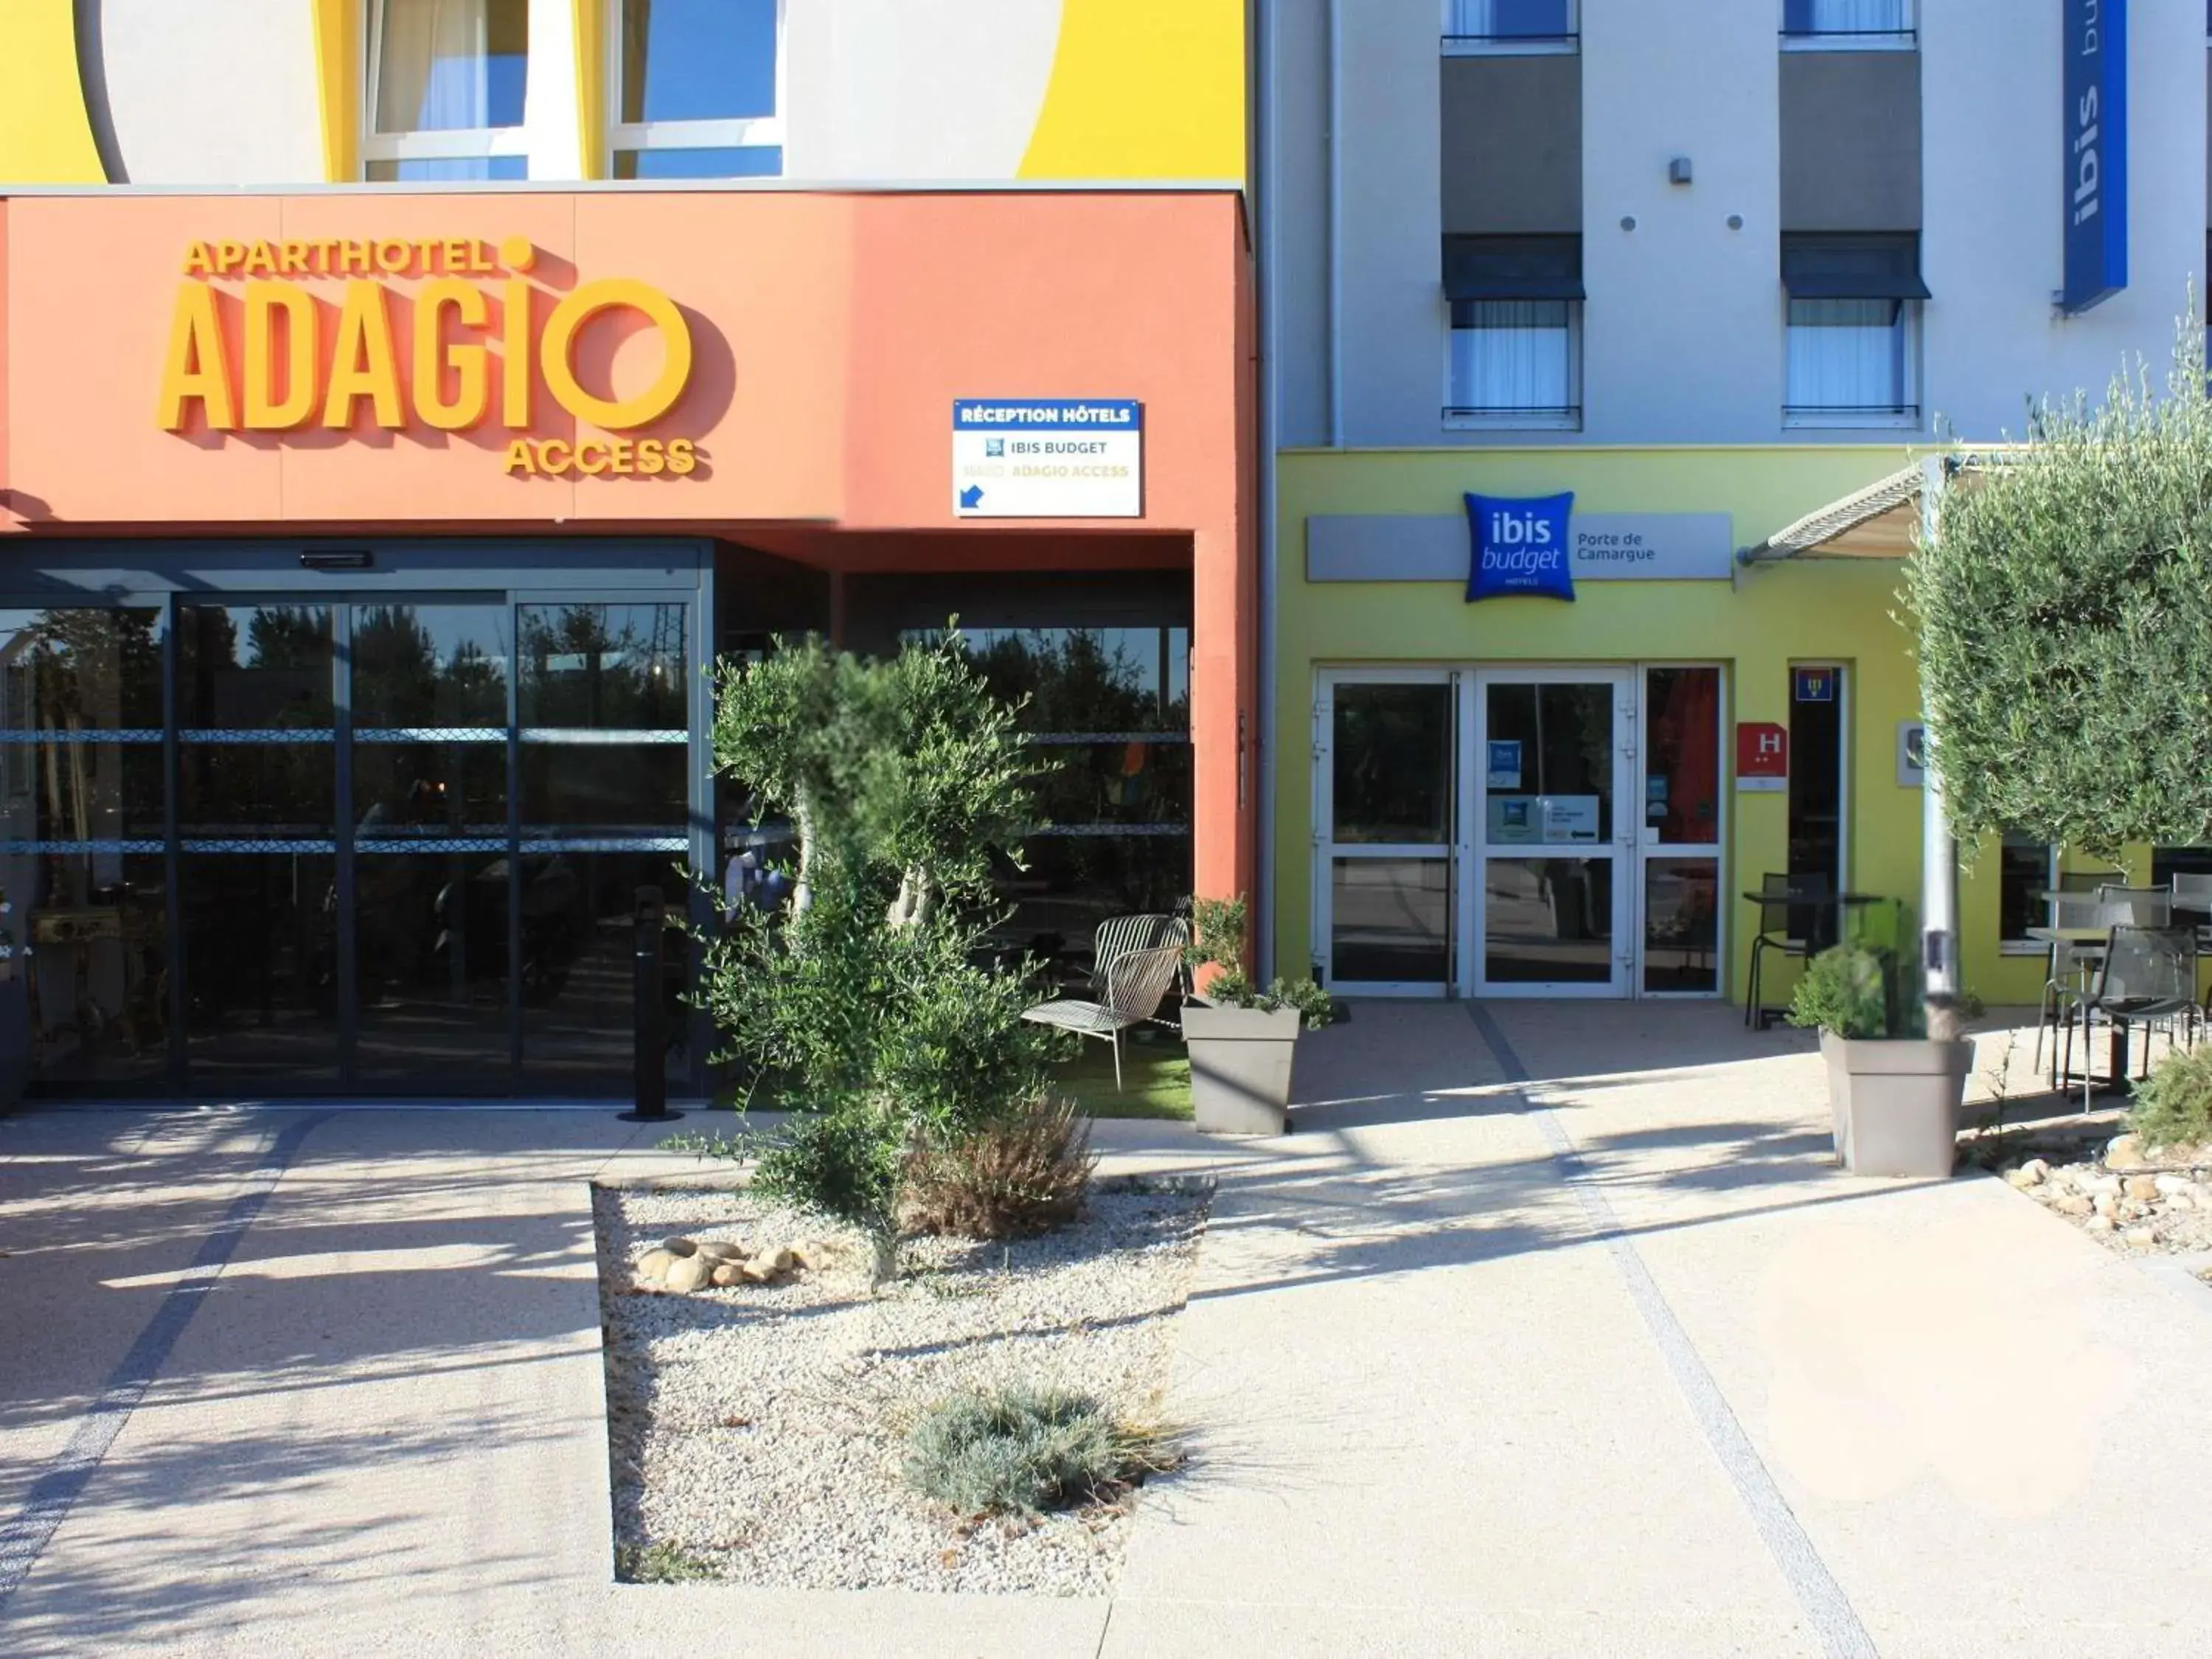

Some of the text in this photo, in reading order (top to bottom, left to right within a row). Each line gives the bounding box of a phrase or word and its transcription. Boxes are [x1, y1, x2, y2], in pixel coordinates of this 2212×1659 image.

[2074, 85, 2098, 226] ibis
[184, 237, 494, 275] APARTHOTEL
[961, 405, 1130, 423] RÉCEPTION HÔTELS
[504, 438, 696, 476] ACCESS
[1011, 442, 1108, 454] IBIS BUDGET
[1012, 465, 1069, 478] ADAGIO
[1071, 465, 1129, 478] ACCESS
[1492, 512, 1551, 544] ibis
[1577, 533, 1643, 546] Porte de
[1482, 546, 1562, 575] budget
[1577, 547, 1656, 563] Camargue
[1759, 732, 1781, 754] H
